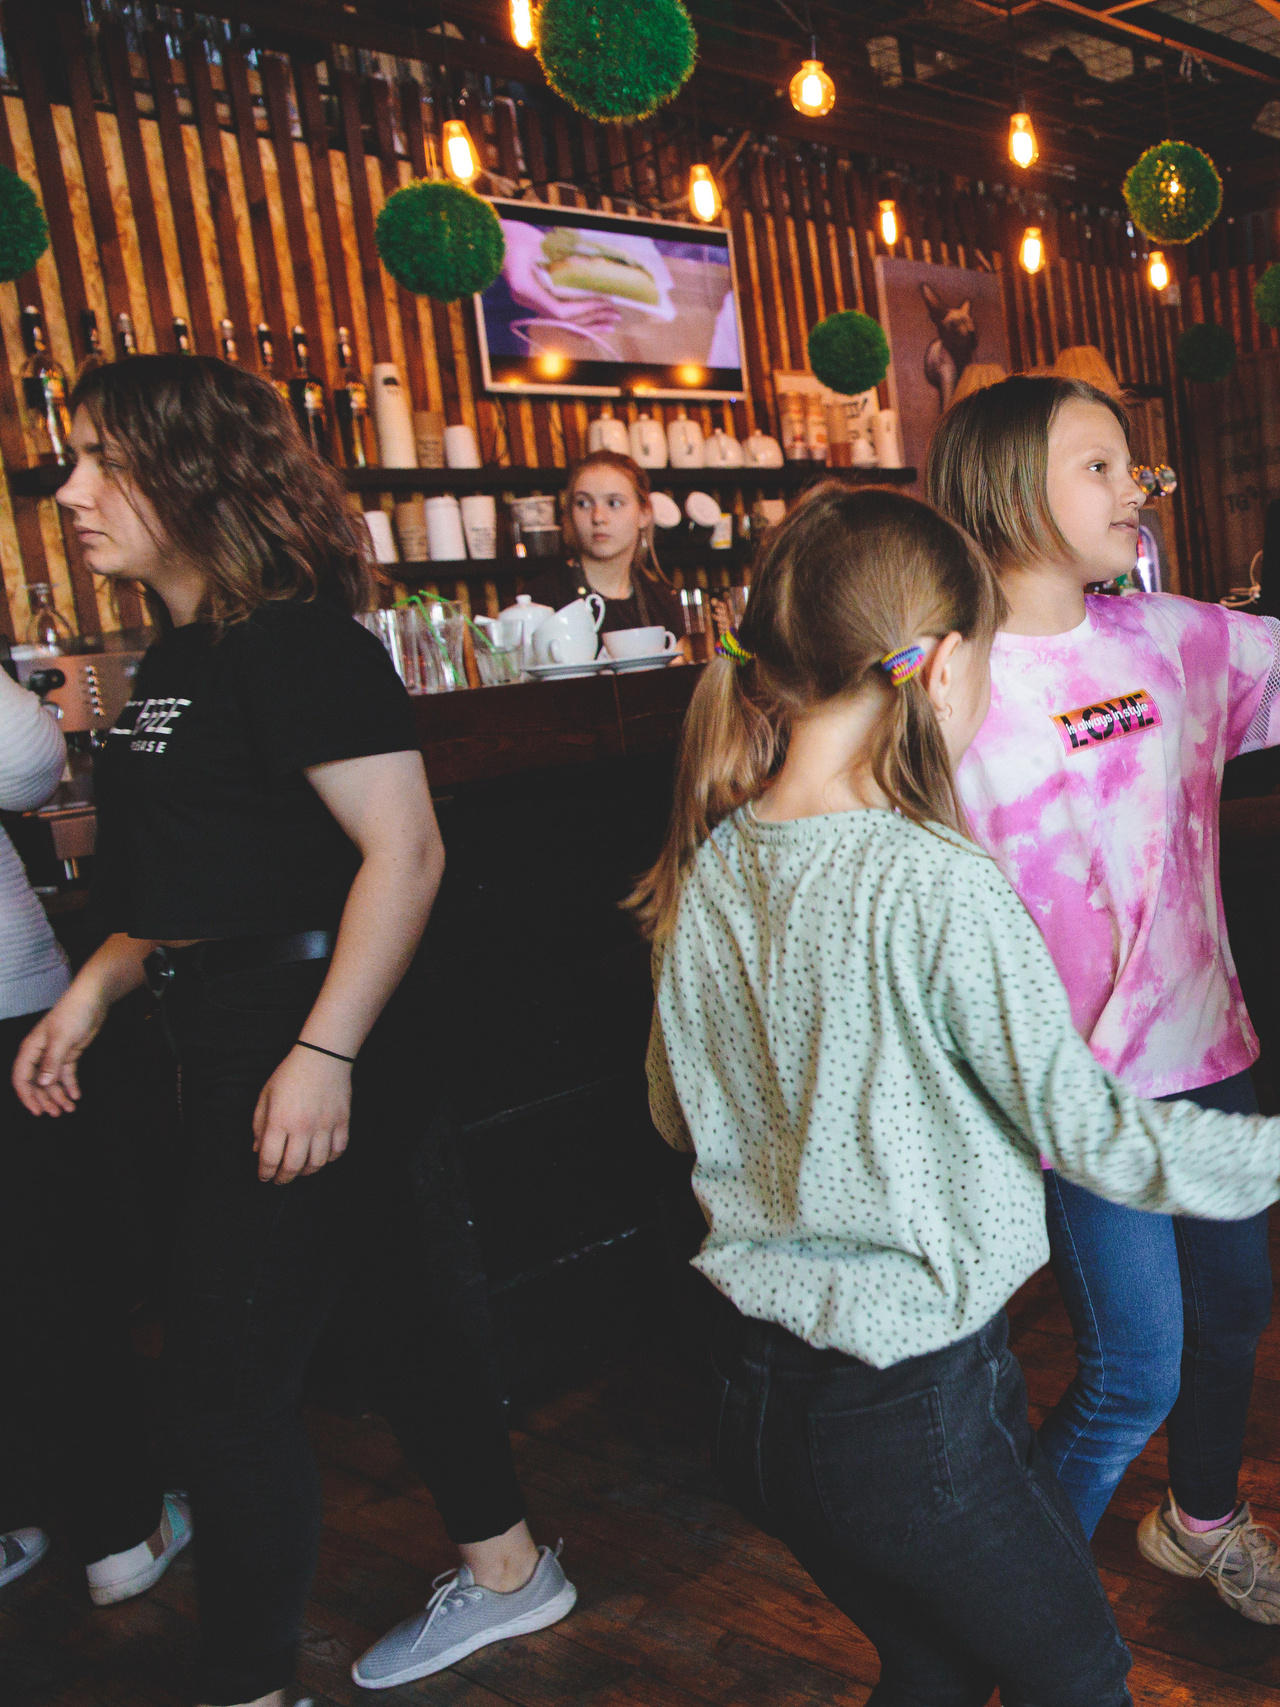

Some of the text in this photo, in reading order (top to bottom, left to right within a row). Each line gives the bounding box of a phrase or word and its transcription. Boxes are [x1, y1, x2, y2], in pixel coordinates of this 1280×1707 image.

[1060, 693, 1155, 749] LOVE
[1077, 712, 1113, 731] always
[1111, 709, 1124, 720] in
[1123, 702, 1148, 718] style
